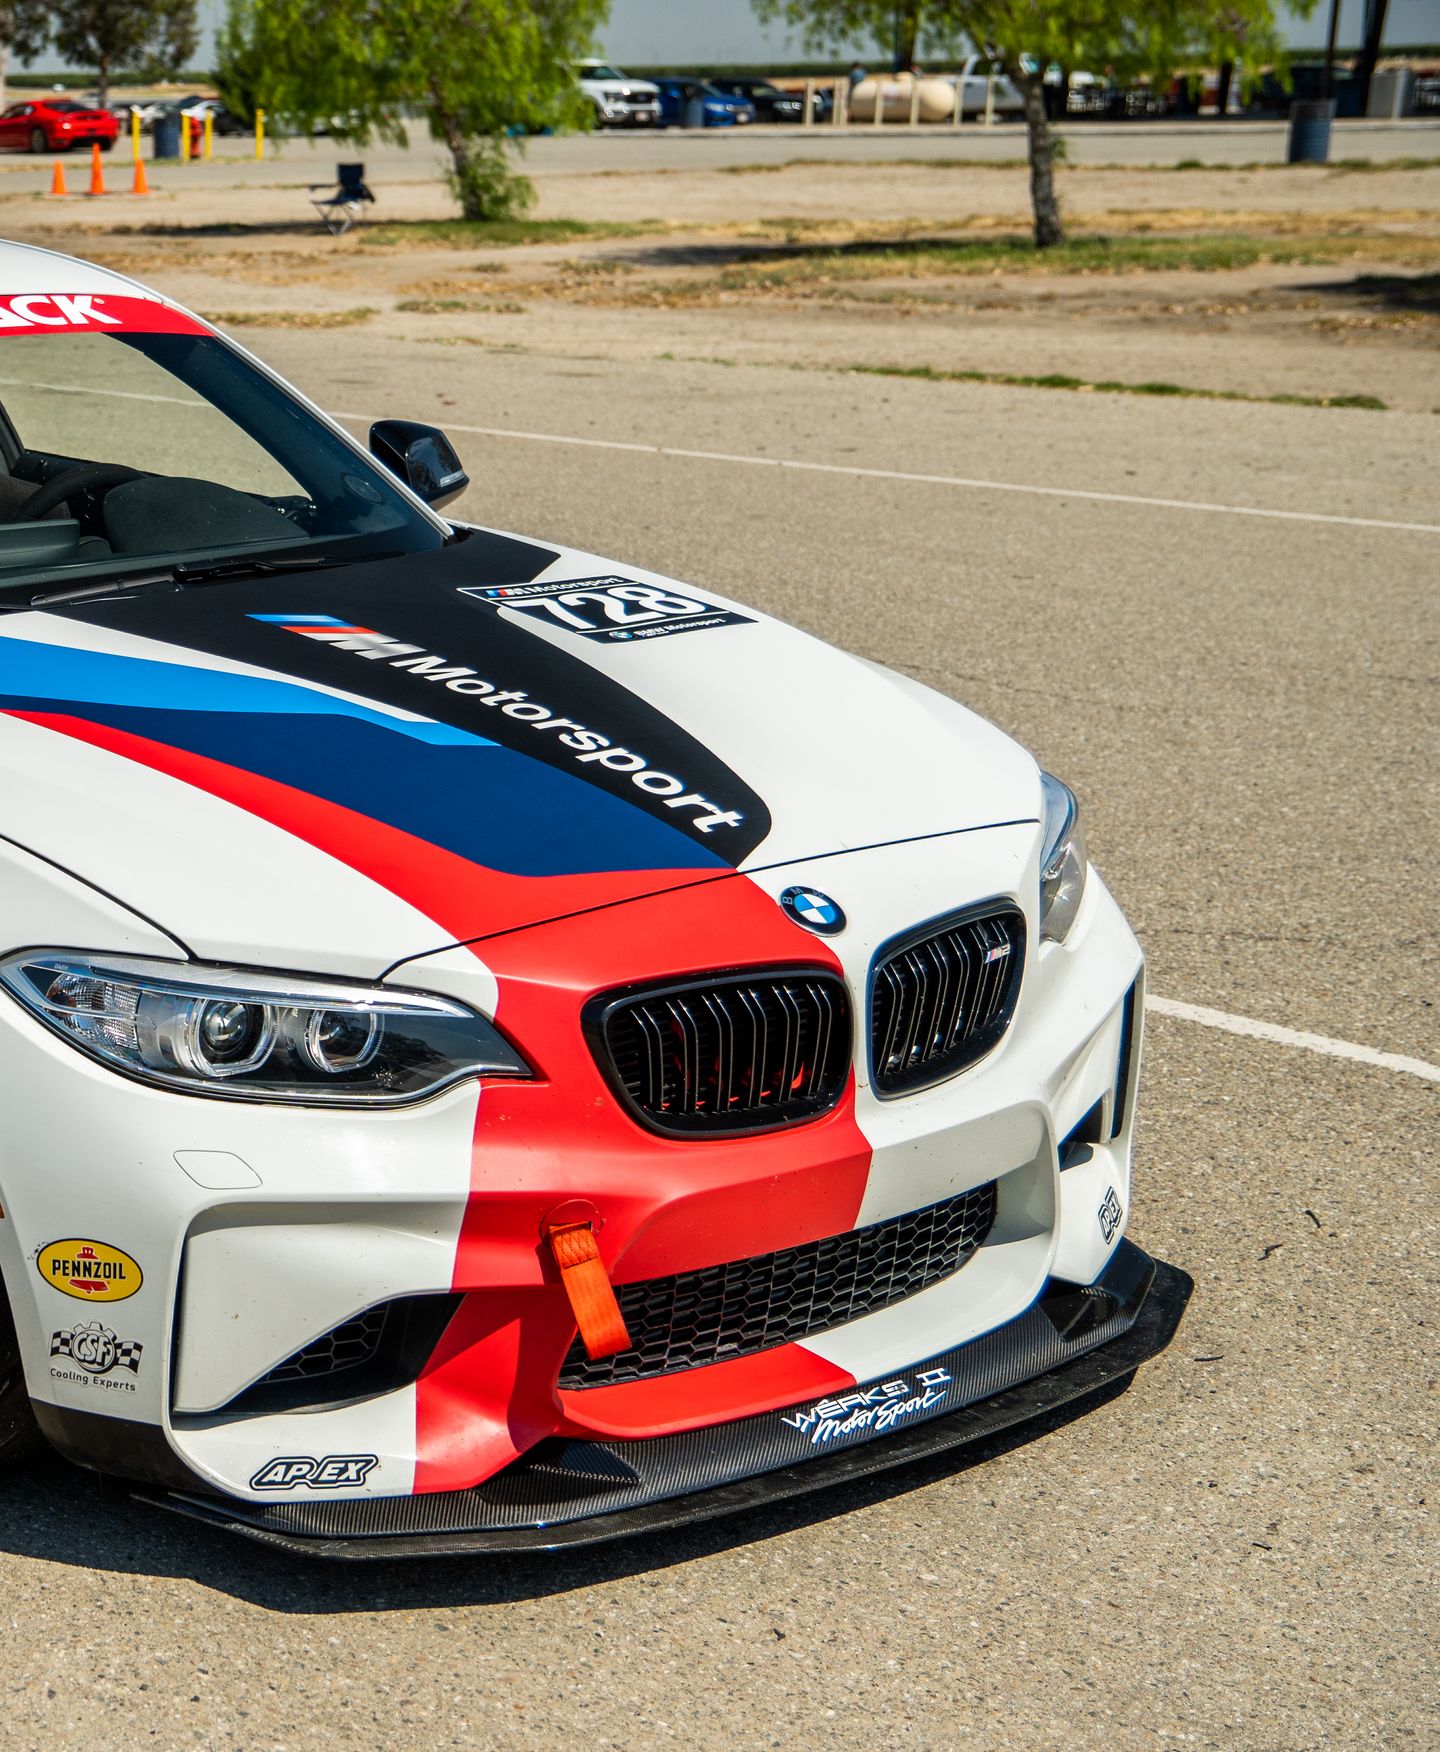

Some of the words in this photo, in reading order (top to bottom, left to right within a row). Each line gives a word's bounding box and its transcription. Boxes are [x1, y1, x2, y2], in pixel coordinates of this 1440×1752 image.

[501, 586, 706, 630] 728
[389, 655, 744, 834] Motorsport
[52, 1258, 126, 1280] PENNZOIL
[73, 1332, 112, 1367] CSF
[50, 1367, 89, 1385] Cooling
[93, 1376, 136, 1392] Experts
